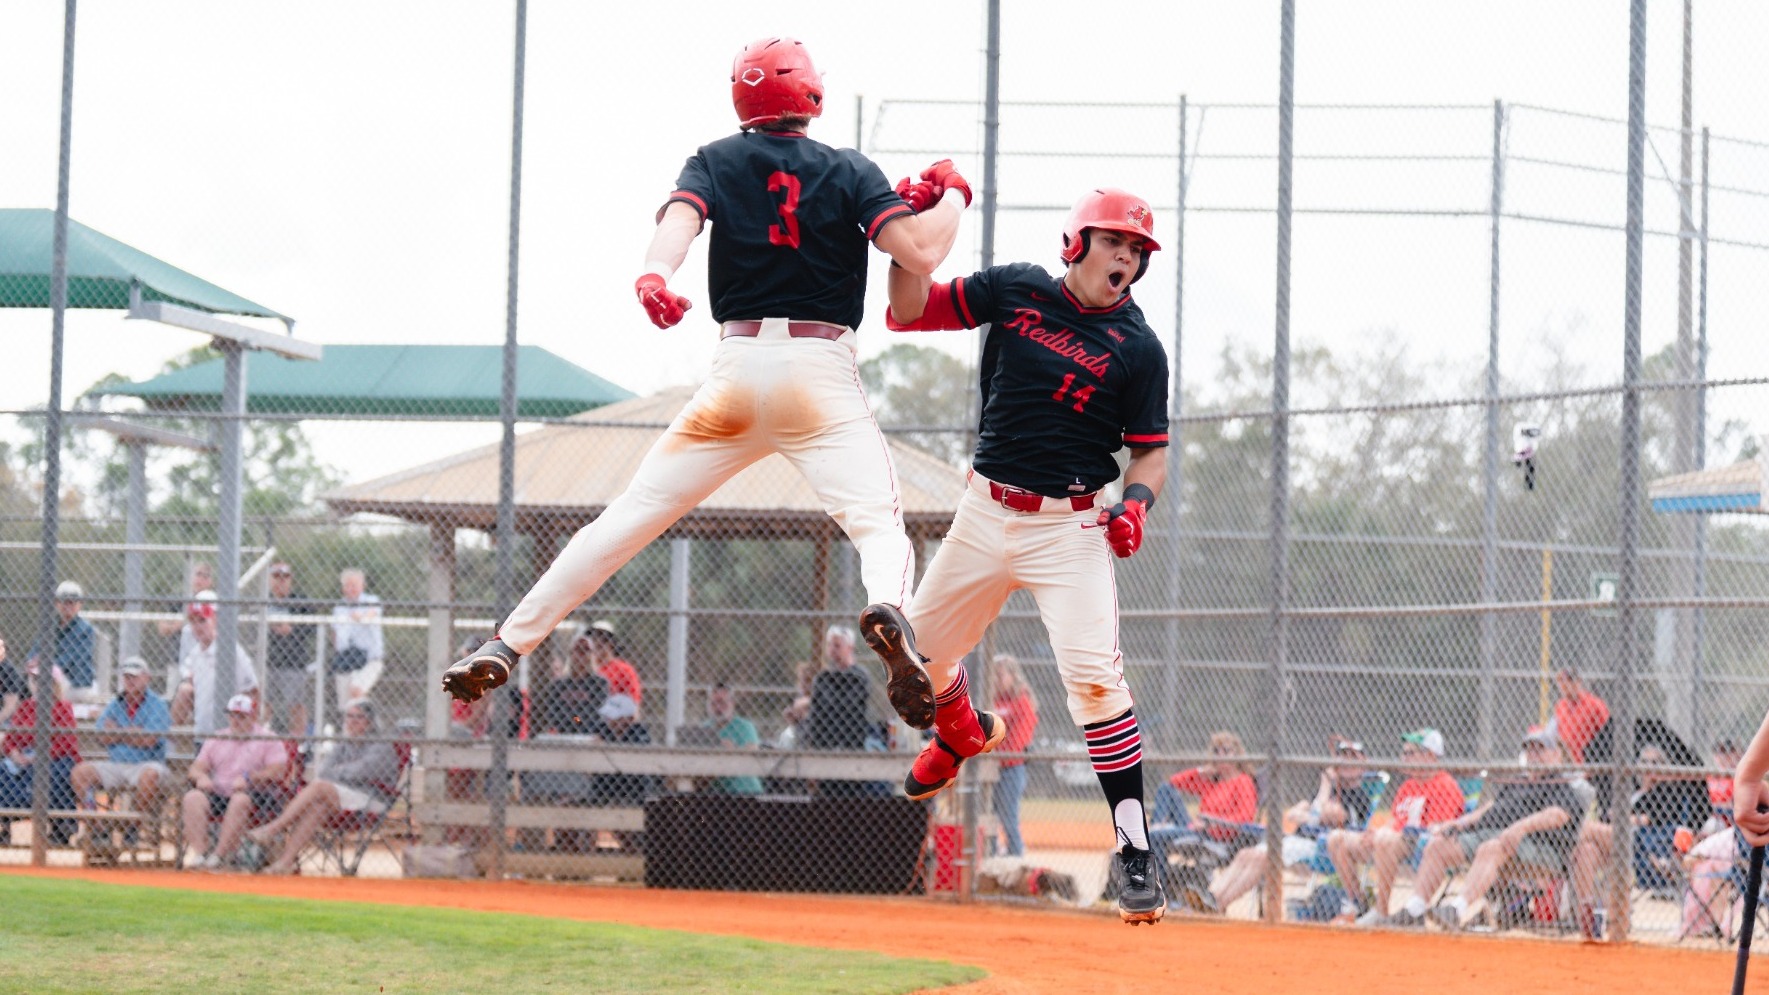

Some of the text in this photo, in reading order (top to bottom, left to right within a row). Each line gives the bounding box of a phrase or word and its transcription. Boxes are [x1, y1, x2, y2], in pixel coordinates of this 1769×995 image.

[766, 170, 801, 249] 3
[1003, 307, 1112, 378] Redbirds
[1052, 372, 1096, 413] 14
